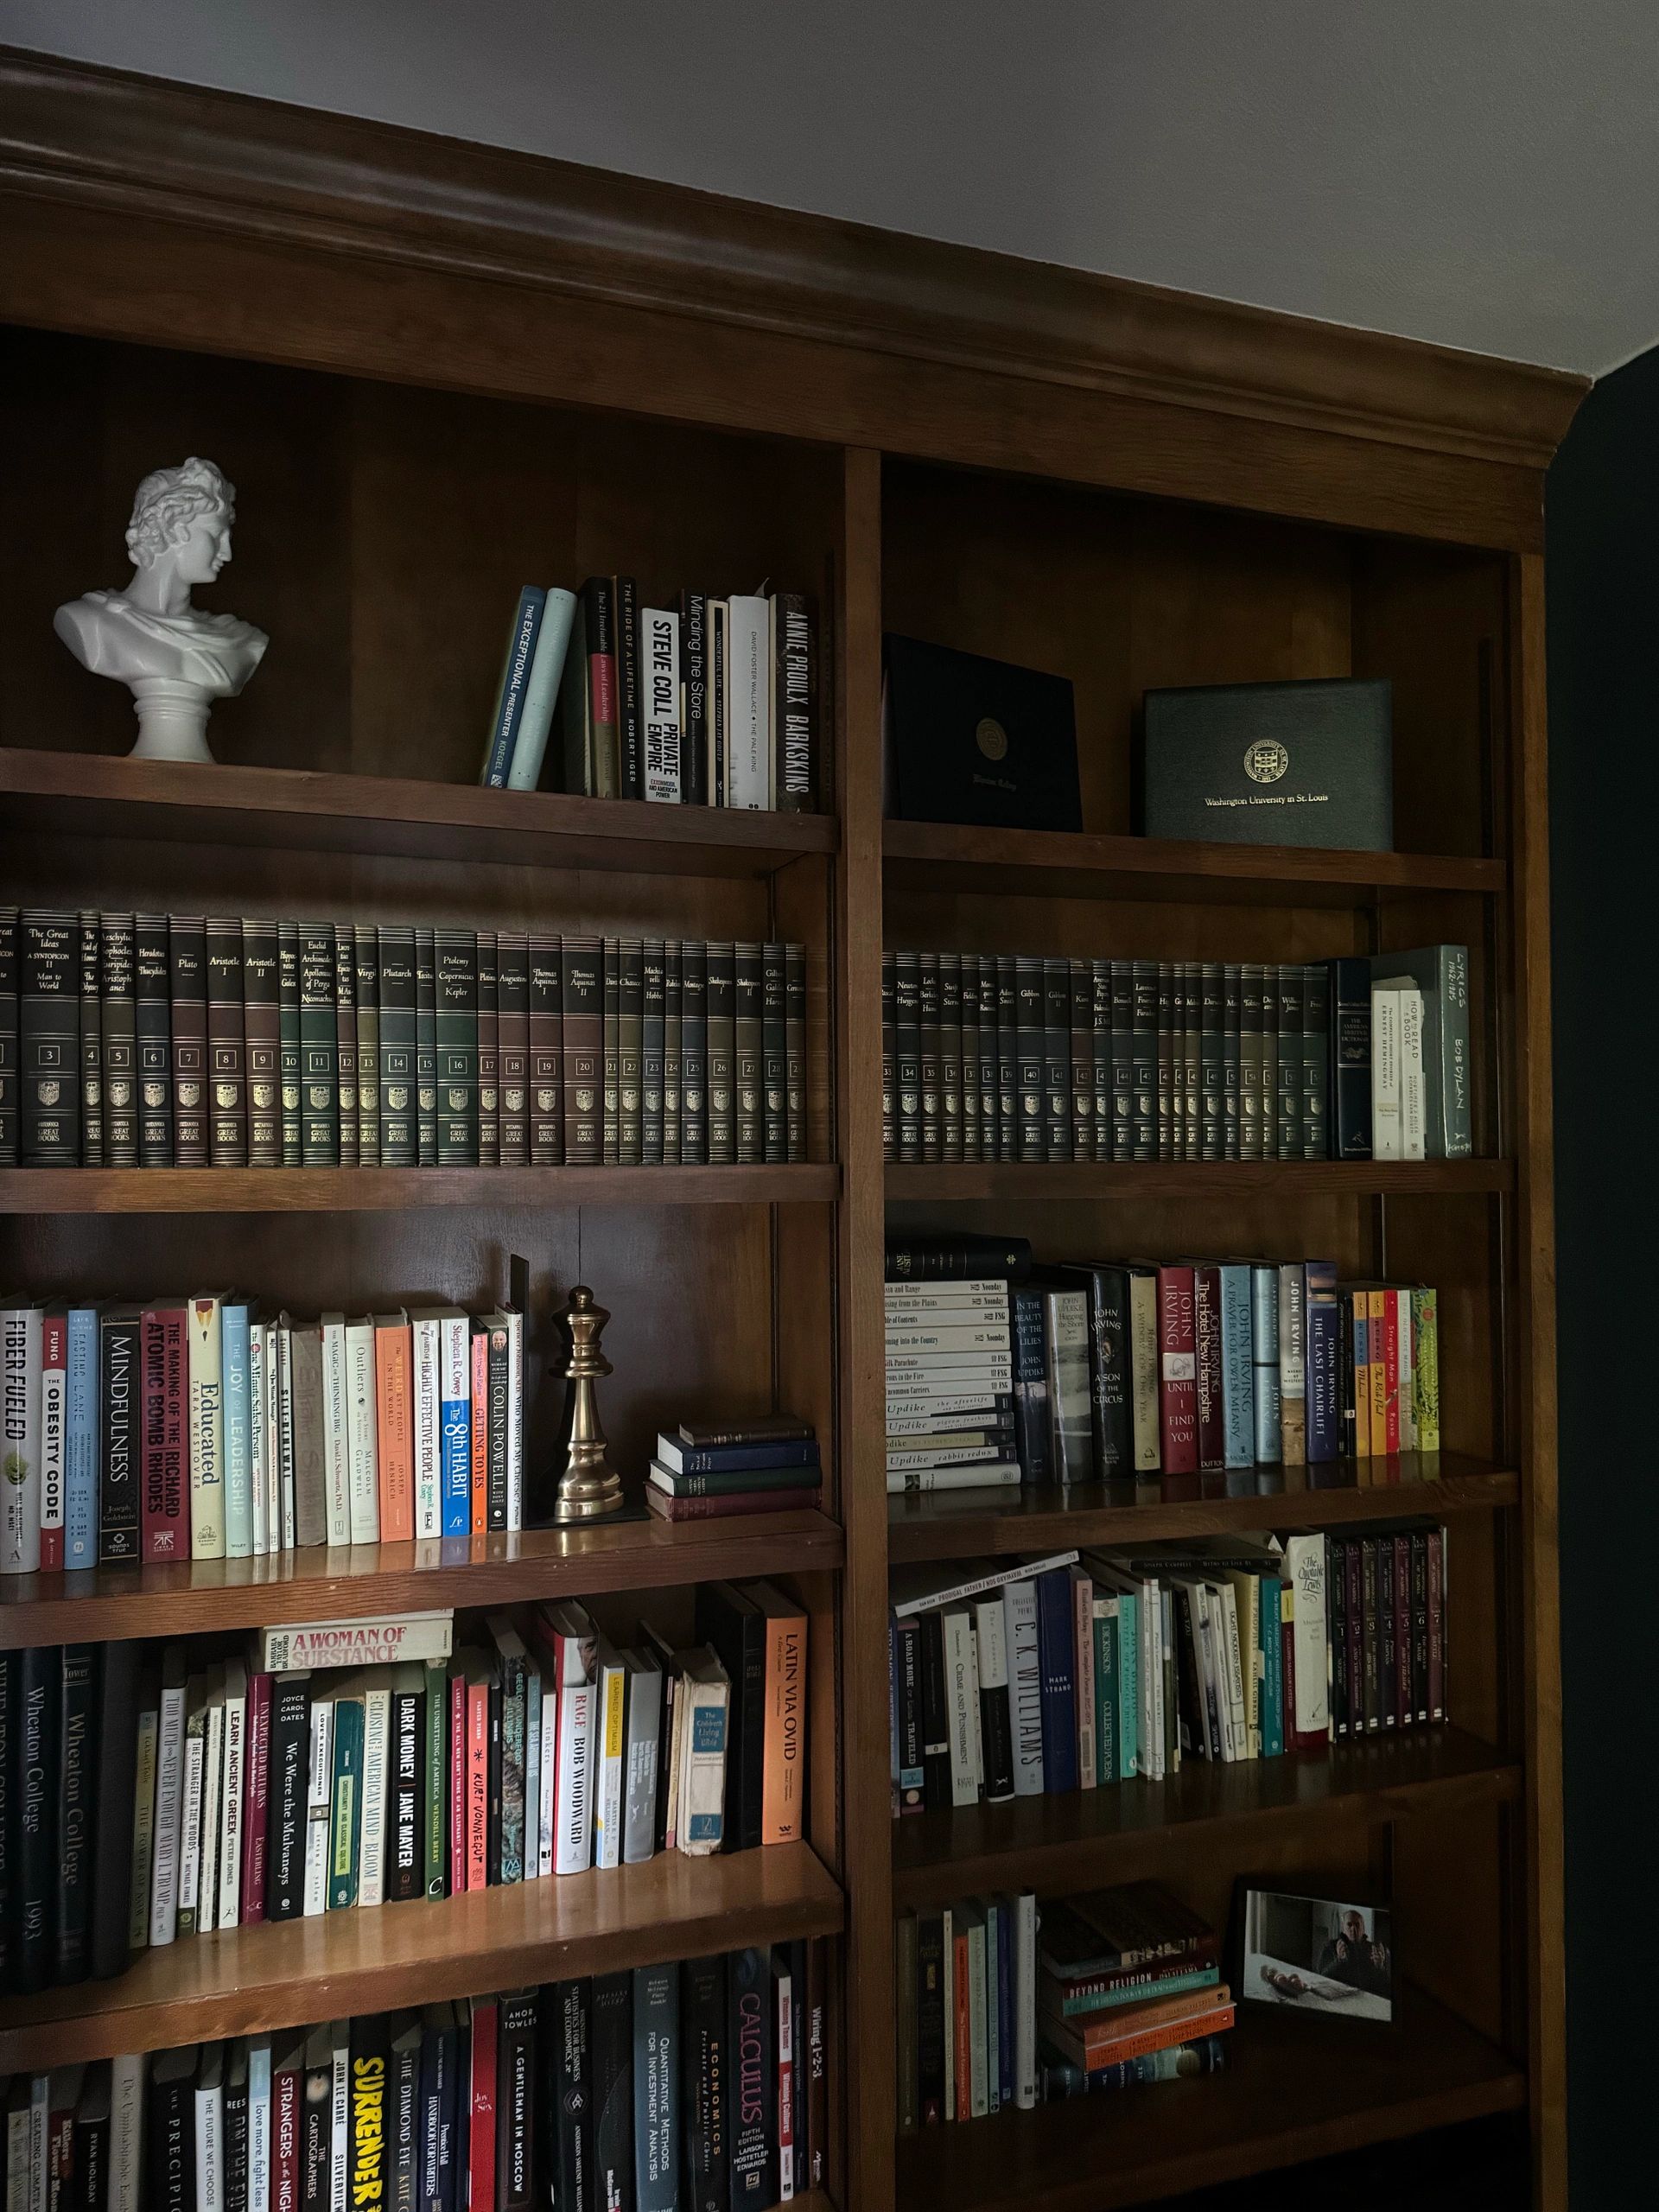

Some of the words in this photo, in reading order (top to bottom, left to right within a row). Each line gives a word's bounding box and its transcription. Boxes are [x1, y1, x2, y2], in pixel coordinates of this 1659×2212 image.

[623, 583, 632, 602] THE
[524, 604, 534, 620] THE
[624, 606, 632, 631] RIDE
[687, 595, 703, 650] Minding
[625, 634, 633, 649] OF
[652, 620, 672, 672] STEVE
[785, 611, 809, 652] ANNIE
[510, 620, 533, 691] EXCEPTIONAL
[690, 655, 702, 678] the
[625, 660, 634, 709] LIFETIME
[653, 675, 672, 716] COLL
[785, 654, 809, 705] PROULX
[502, 691, 517, 737] PRESENTER
[690, 681, 702, 720] Store
[494, 740, 508, 770] KOEGEL
[647, 723, 663, 772] EMPIRE
[663, 722, 678, 776] PRIVATE
[785, 715, 810, 793] BARKSKINS
[1204, 797, 1247, 807] Washington
[1249, 795, 1285, 806] University
[1295, 794, 1306, 803] St.
[29, 928, 45, 938] The
[46, 929, 69, 939] Great
[41, 938, 60, 948] Ideas
[178, 959, 198, 969] Plato
[210, 957, 240, 966] Aristotle
[222, 968, 227, 976] I
[246, 957, 276, 967] Aristotle
[257, 969, 265, 977] II
[383, 969, 412, 978] Plutarch
[438, 971, 474, 982] Copernicus
[443, 956, 469, 966] Ptolemy
[445, 988, 467, 999] Kepler
[1456, 953, 1465, 1008] LYRICS
[46, 1051, 53, 1060] 3
[223, 1055, 229, 1064] 8
[259, 1056, 266, 1065] 9
[394, 1059, 404, 1068] 14
[1455, 1039, 1464, 1064] BOB
[1455, 1065, 1464, 1109] DYLAN
[981, 1283, 1002, 1292] Noonday
[1198, 1280, 1210, 1302] The
[1165, 1285, 1179, 1347] IRVING
[1179, 1292, 1192, 1338] JOHN
[1199, 1304, 1211, 1333] Hotel
[1314, 1318, 1323, 1338] THE
[5, 1320, 26, 1372] FIBER
[50, 1331, 59, 1361] FUNG
[146, 1323, 165, 1389] ATOMIC
[452, 1325, 463, 1359] Stephen
[1199, 1333, 1211, 1359] New
[1314, 1343, 1324, 1371] LAST
[231, 1365, 243, 1394] JOY
[357, 1347, 365, 1393] Outliers
[421, 1360, 433, 1395] HIGHLY
[452, 1361, 462, 1371] R.
[452, 1372, 463, 1396] Covey
[1167, 1382, 1194, 1394] UNTIL
[1198, 1360, 1212, 1425] Hampshire
[5, 1376, 26, 1440] FUELED
[111, 1336, 131, 1483] MINDFULNESS
[147, 1395, 165, 1446] BOMB
[234, 1402, 241, 1410] OF
[421, 1395, 433, 1446] EFFECTIVE
[449, 1408, 459, 1421] The
[493, 1385, 505, 1429] COLIN
[1169, 1414, 1195, 1427] FIND
[1179, 1399, 1184, 1409] I
[1315, 1376, 1325, 1437] CHAIRLIFT
[47, 1388, 60, 1465] OBESITY
[200, 1382, 219, 1486] Educated
[444, 1423, 468, 1452] 8th
[1172, 1431, 1193, 1444] YOU
[230, 1416, 245, 1516] LEADERSHIP
[422, 1446, 433, 1482] PEOPLE
[452, 1453, 468, 1499] HABIT
[493, 1432, 505, 1490] POWELL
[46, 1473, 59, 1519] CODE
[148, 1452, 164, 1514] RHODES
[164, 1451, 180, 1518] RICHARD
[292, 1635, 308, 1650] A
[308, 1628, 383, 1648] WOMAN
[385, 1626, 408, 1643] OF
[1014, 1621, 1036, 1637] C.
[292, 1644, 399, 1669] SUBSTANCE
[785, 1634, 798, 1681] LATIN
[1015, 1643, 1038, 1661] K.
[1102, 1625, 1111, 1675] DICKINSON
[1045, 1684, 1071, 1694] STRAND
[1048, 1675, 1068, 1685] MARK
[281, 1694, 305, 1703] JOYCE
[281, 1704, 305, 1713] CAROL
[400, 1698, 416, 1732] DARK
[574, 1694, 587, 1729] RAGE
[785, 1685, 798, 1715] VIA
[1017, 1667, 1042, 1765] WILLIAMS
[27, 1686, 45, 1763] Wheaton
[231, 1710, 240, 1746] LEARN
[783, 1719, 797, 1761] OVID
[285, 1741, 298, 1761] We
[400, 1736, 416, 1779] MONEY
[573, 1737, 586, 1765] BOB
[229, 1749, 239, 1796] ANCIENT
[284, 1761, 297, 1796] Were
[474, 1771, 485, 1802] KURT
[22, 1766, 45, 1834] College
[227, 1798, 238, 1836] GREEK
[283, 1797, 296, 1818] the
[399, 1791, 415, 1823] JANE
[570, 1769, 585, 1845] WOODWARD
[280, 1818, 297, 1886] Mulvaneys
[398, 1825, 415, 1868] MAYER
[473, 1806, 485, 1863] VONNEGUT
[23, 1900, 43, 1941] 1993
[1069, 1984, 1105, 1999] BEYOND
[1109, 1973, 1152, 1990] RELIGION
[505, 2018, 537, 2029] TOWLES
[508, 2008, 533, 2019] AMOR
[648, 2032, 657, 2052] FOR
[739, 1993, 763, 2124] CALCULUS
[514, 2056, 525, 2122] GENTLEMAN
[648, 2056, 658, 2123] INVESTMENT
[659, 2037, 670, 2113] QUANTITATIVE
[205, 2099, 213, 2115] THE
[710, 2042, 721, 2155] ECONOMICS
[205, 2118, 214, 2151] FUTURE
[279, 2076, 293, 2159] STRANGERS
[352, 2056, 385, 2207] SURRENDER
[514, 2126, 524, 2139] IN
[205, 2152, 214, 2165] WE
[307, 2113, 319, 2199] CARTOGRAPHERS
[649, 2129, 658, 2182] ANALYSIS
[660, 2119, 670, 2171] METHODS
[513, 2141, 524, 2192] MOSCOW
[205, 2167, 214, 2207] CHOOSE
